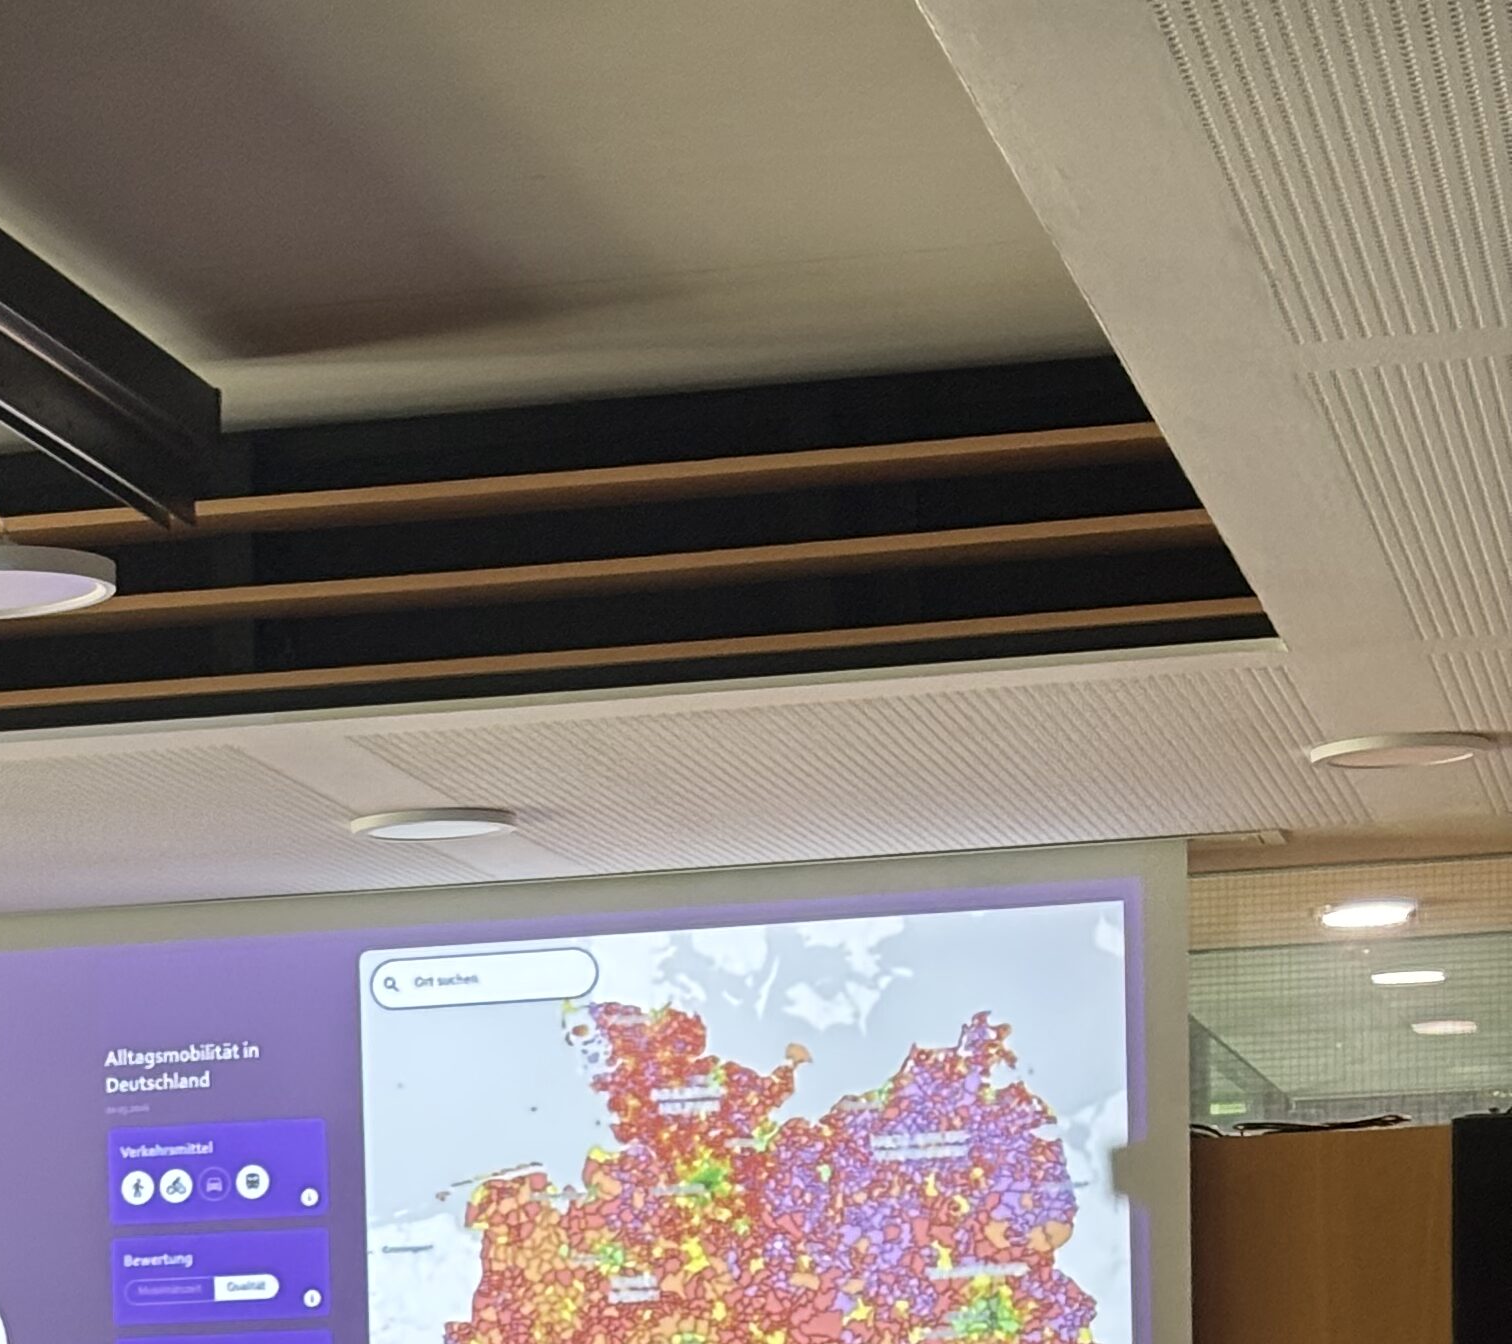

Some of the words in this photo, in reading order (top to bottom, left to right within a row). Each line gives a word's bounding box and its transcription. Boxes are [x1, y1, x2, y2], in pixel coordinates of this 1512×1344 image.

[104, 1041, 239, 1070] Alltagsmobilität
[242, 1041, 261, 1060] in
[105, 1071, 211, 1094] Deutschland
[119, 1141, 214, 1159] Verkehrsmittel
[123, 1253, 194, 1269] Bewertung
